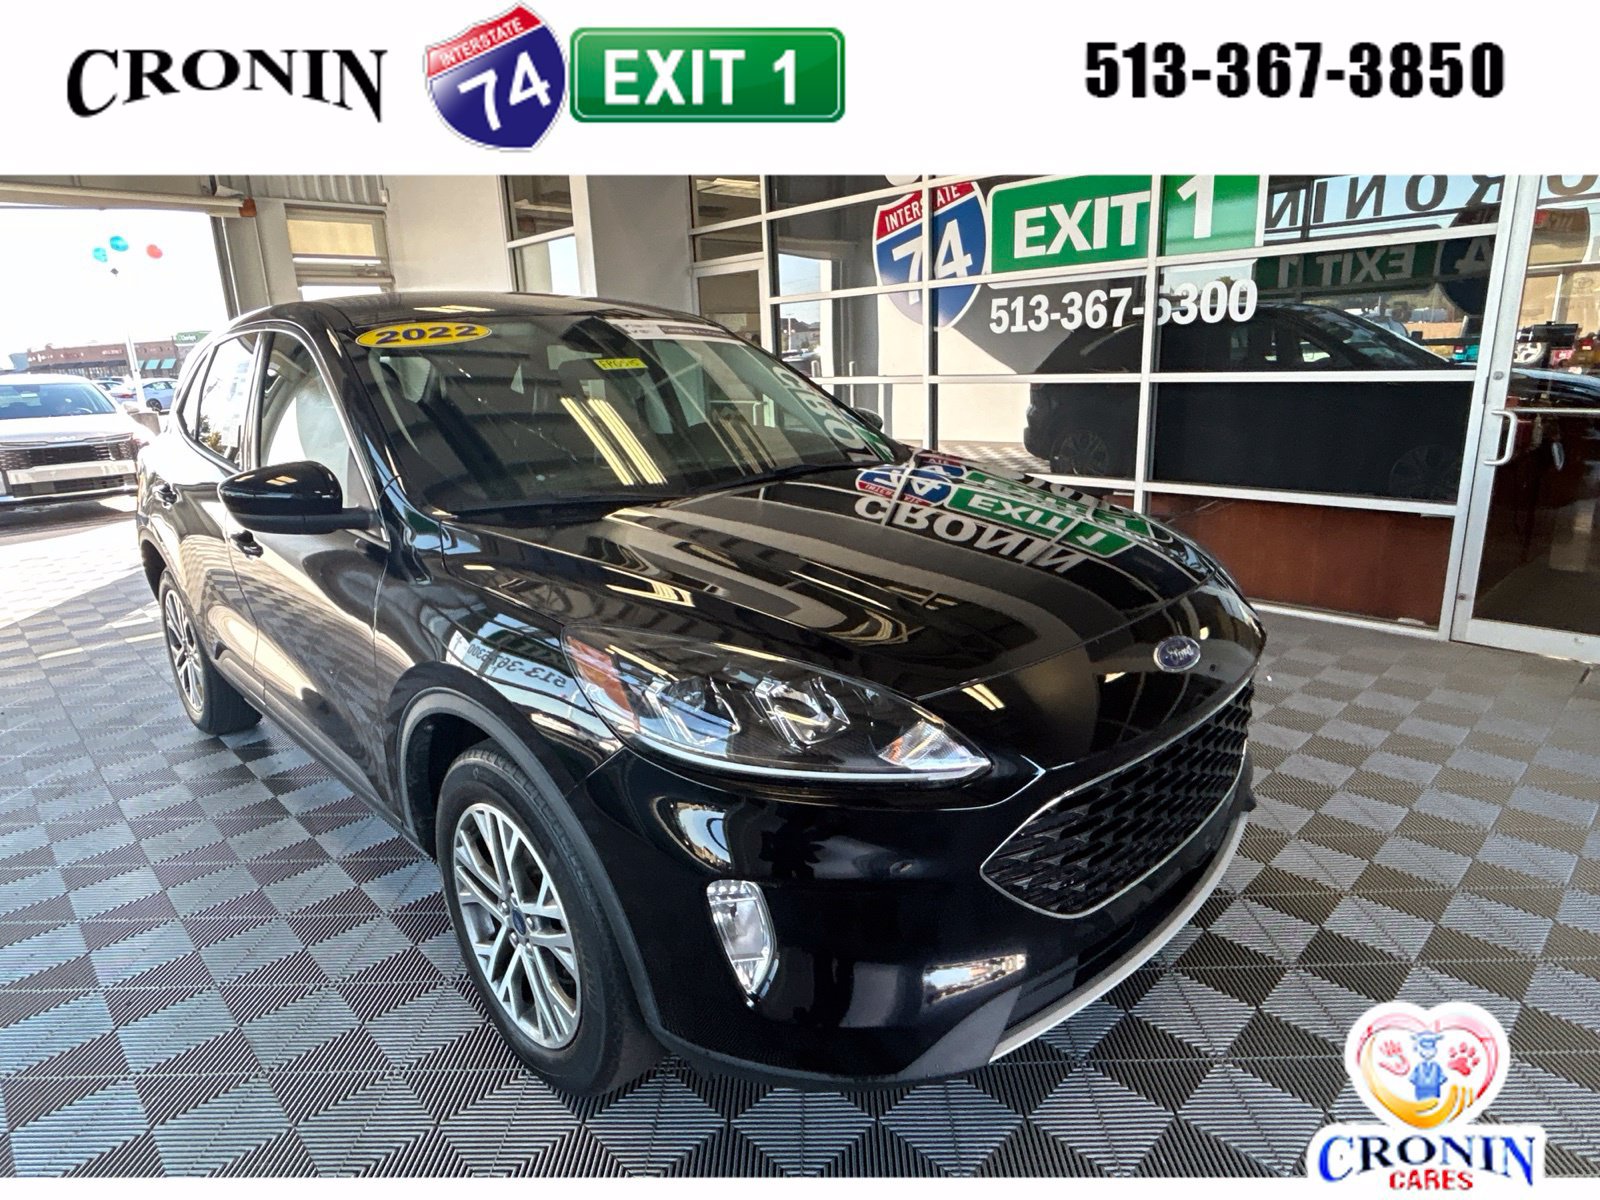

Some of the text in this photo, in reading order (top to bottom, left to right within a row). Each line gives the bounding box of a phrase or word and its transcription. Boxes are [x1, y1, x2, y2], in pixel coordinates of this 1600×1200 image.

[1014, 174, 1216, 259] EXIT 1
[892, 219, 974, 305] 74
[375, 325, 479, 344] 2022
